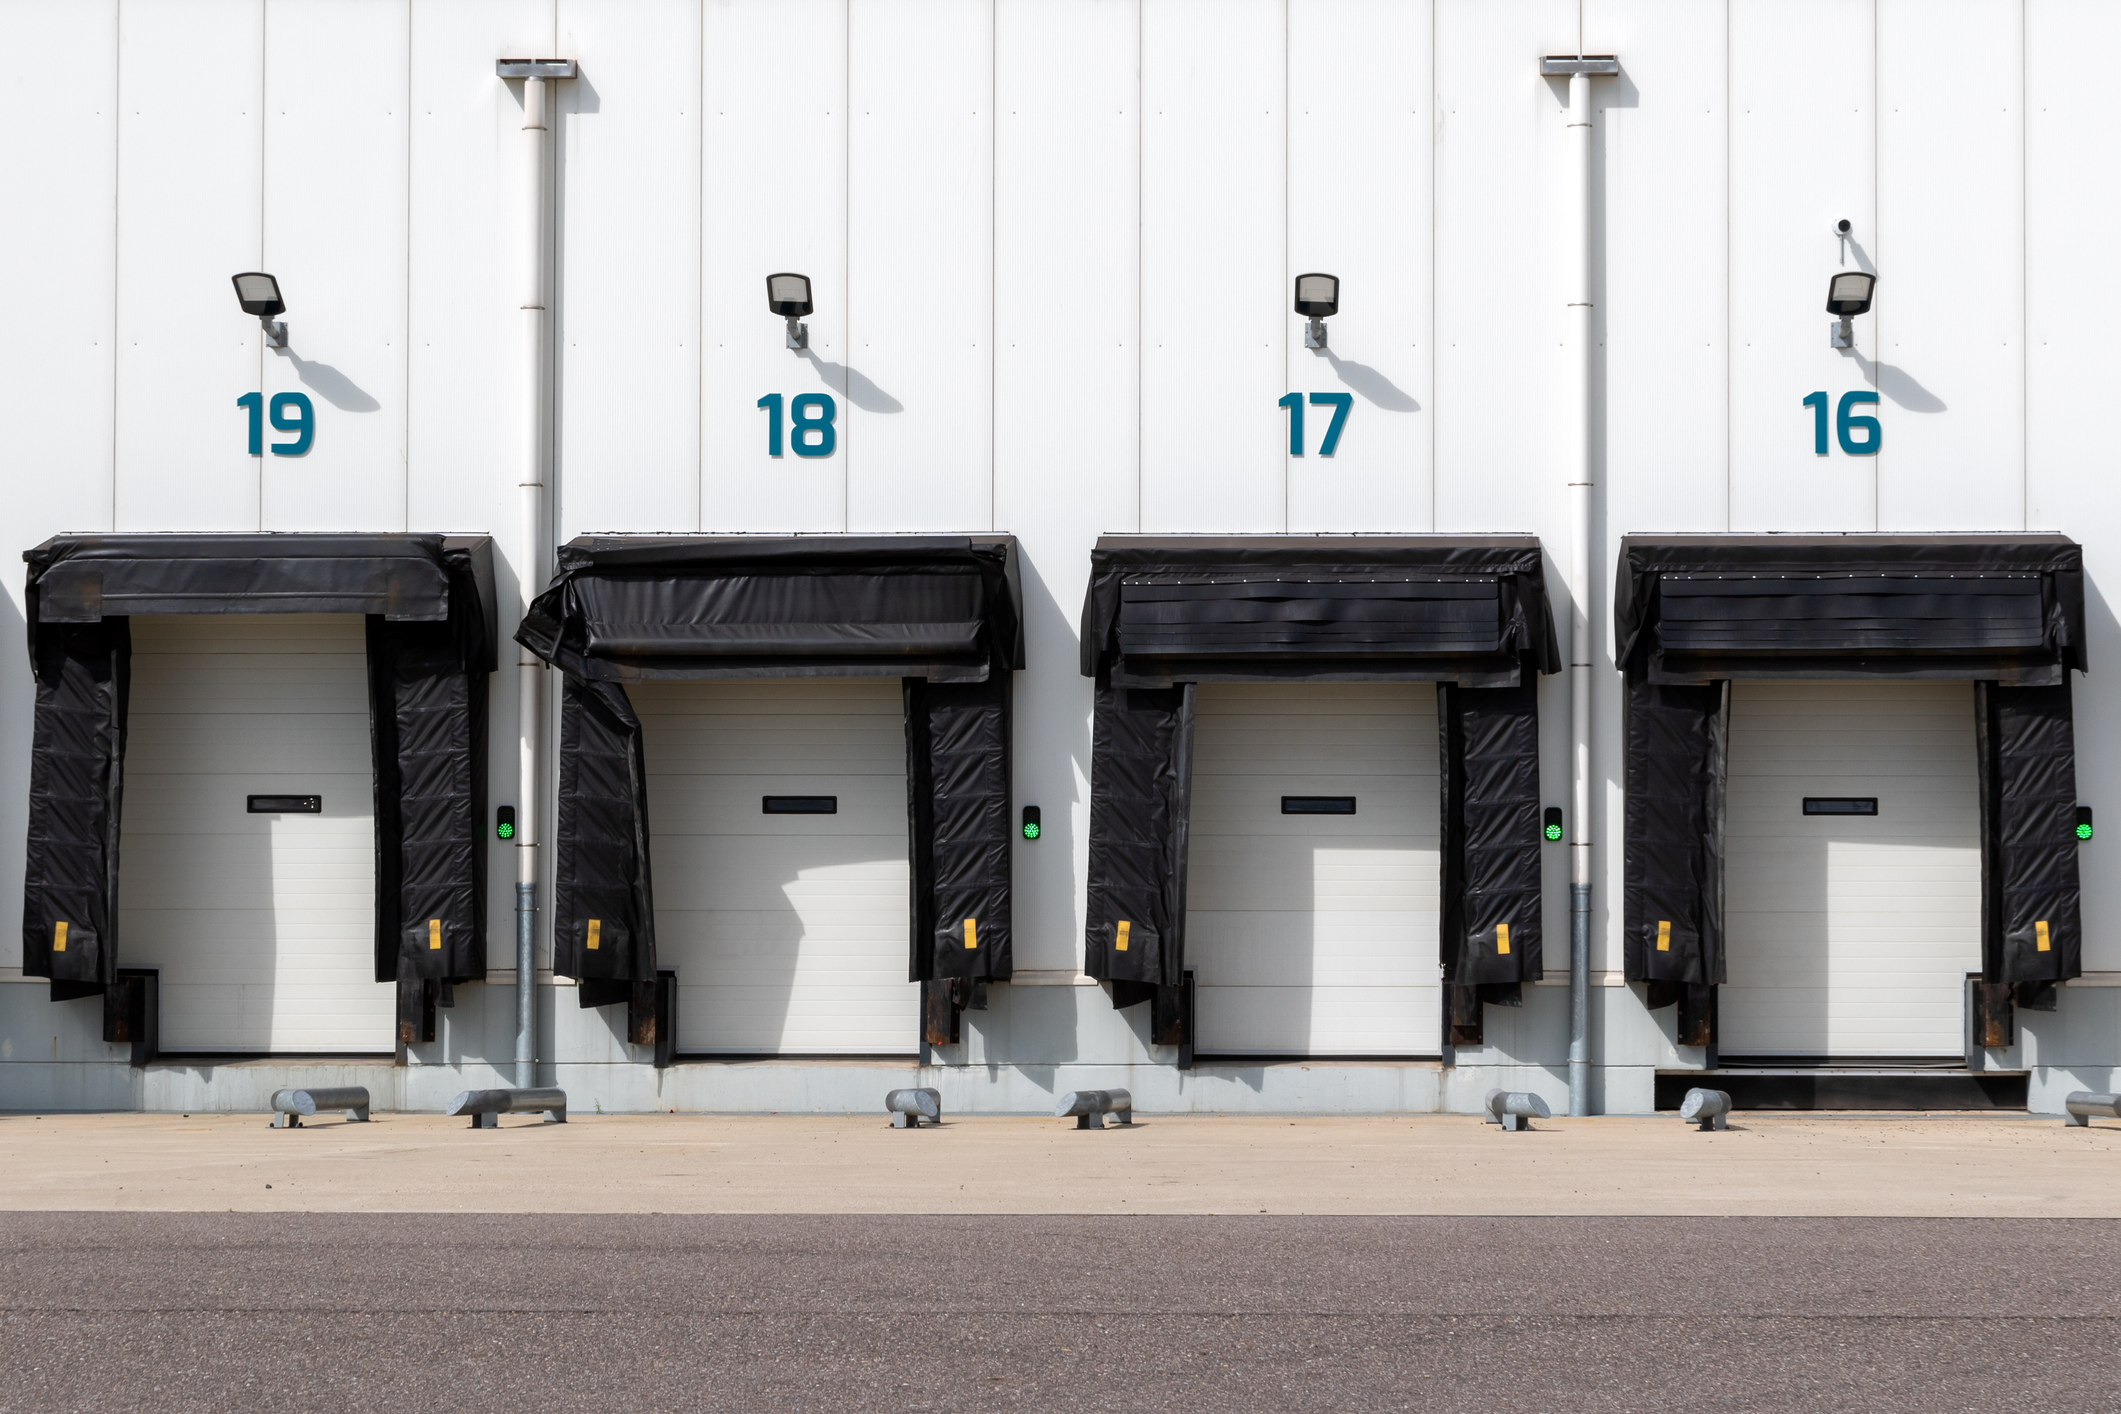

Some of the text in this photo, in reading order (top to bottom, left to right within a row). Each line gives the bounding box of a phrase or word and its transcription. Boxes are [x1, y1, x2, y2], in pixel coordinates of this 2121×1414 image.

[237, 392, 314, 455] 19
[757, 393, 835, 455] 18
[1278, 392, 1353, 455] 17
[1803, 391, 1881, 455] 16
